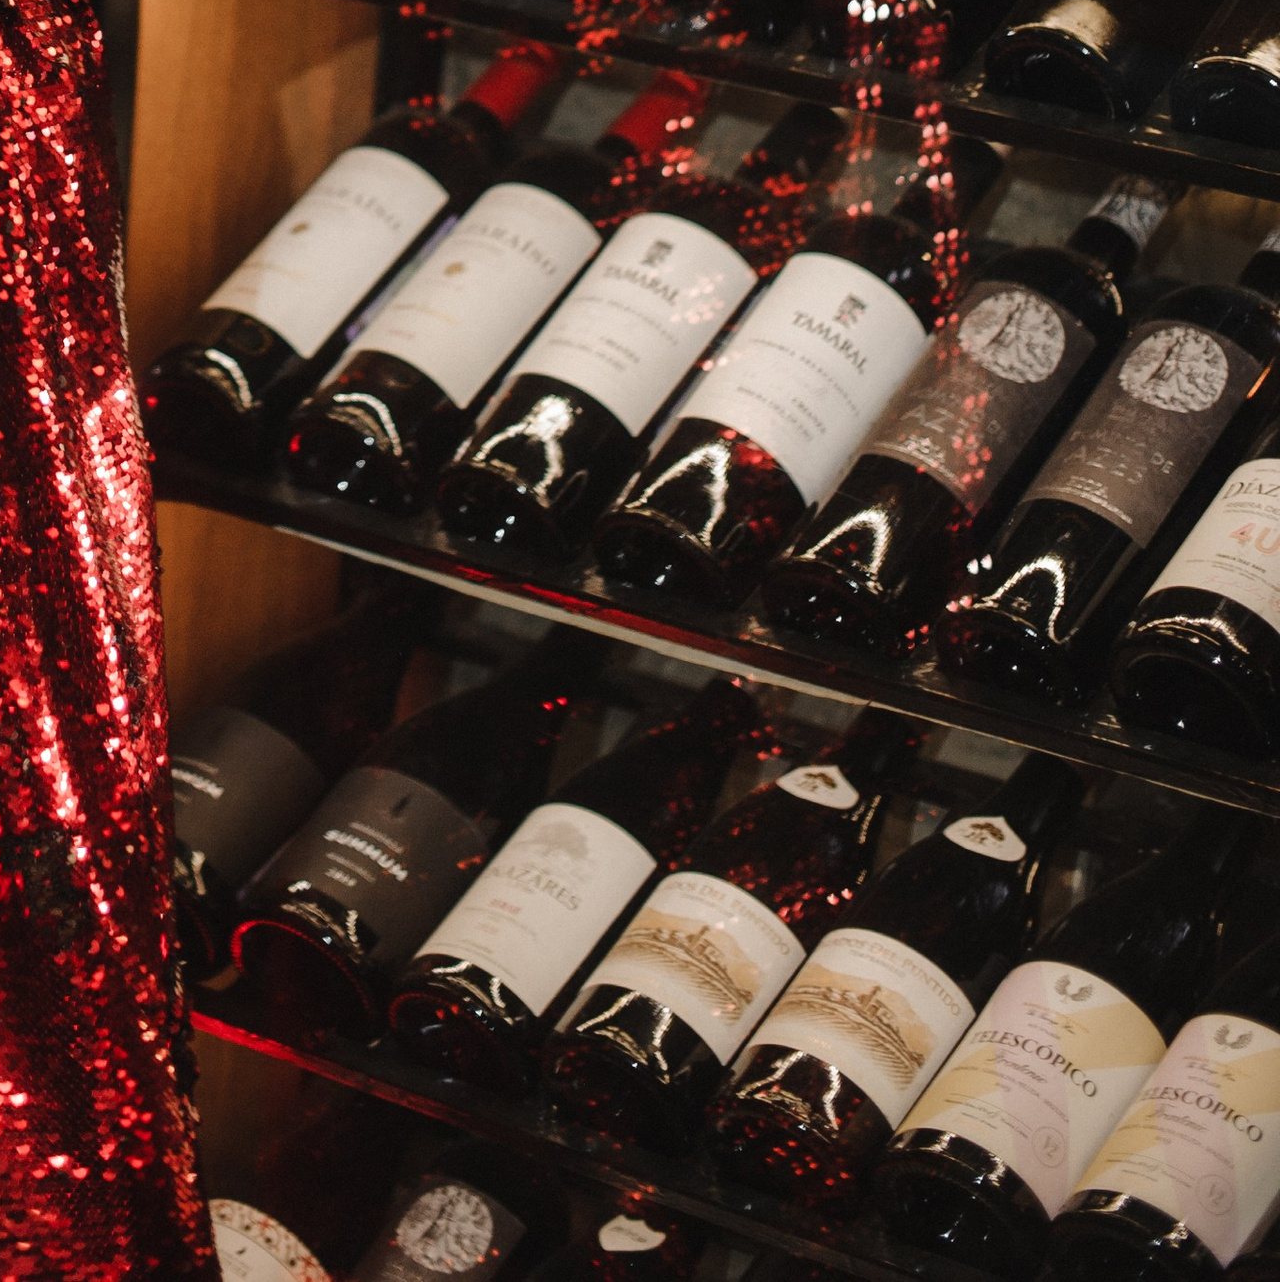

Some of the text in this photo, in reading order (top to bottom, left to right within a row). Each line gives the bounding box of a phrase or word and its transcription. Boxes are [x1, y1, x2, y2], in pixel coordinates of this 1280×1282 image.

[792, 309, 868, 375] TAMARAL
[323, 829, 408, 881] SUMMUM
[972, 1030, 1097, 1097] TELESCÓPICO
